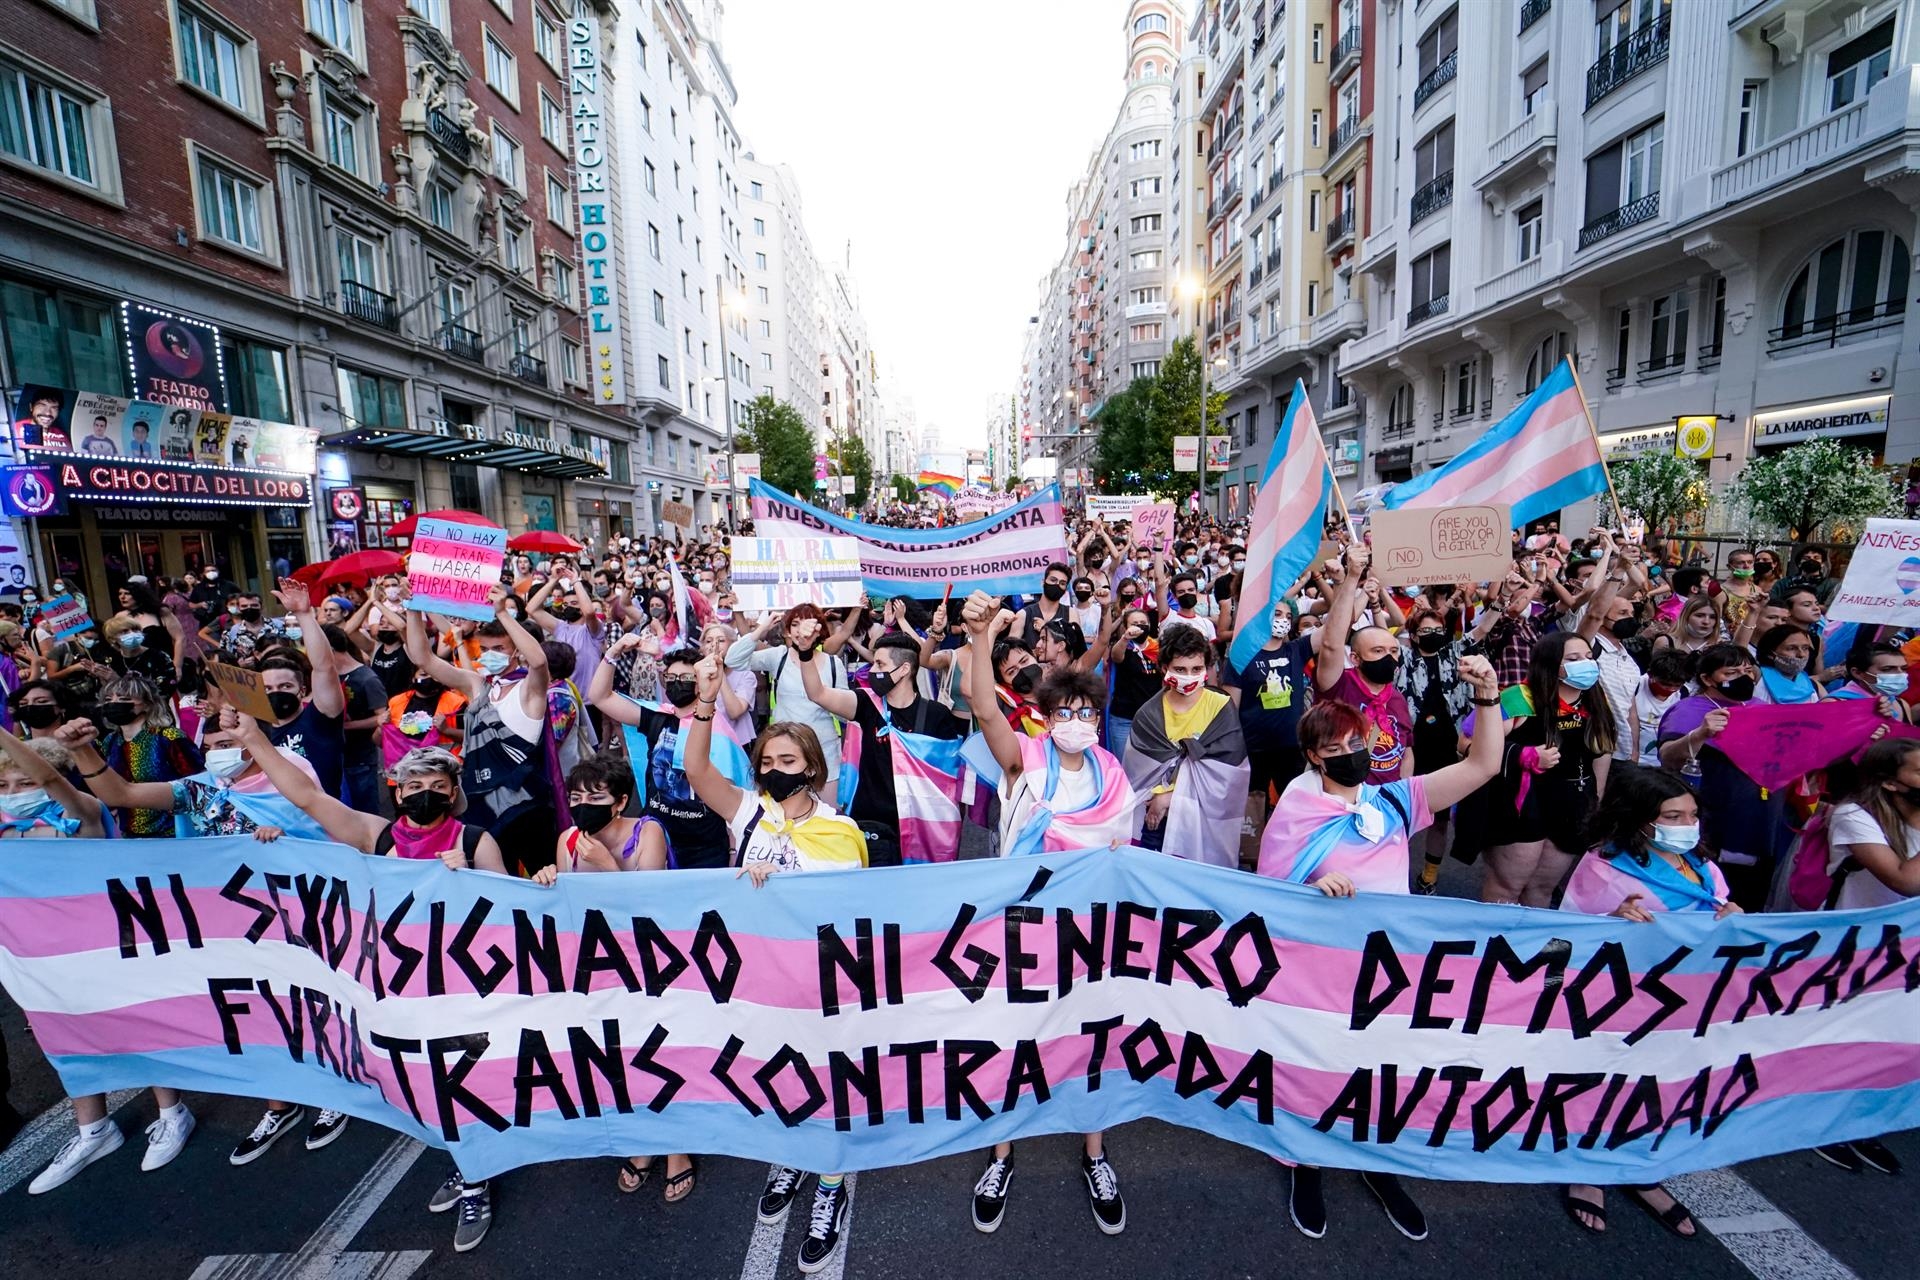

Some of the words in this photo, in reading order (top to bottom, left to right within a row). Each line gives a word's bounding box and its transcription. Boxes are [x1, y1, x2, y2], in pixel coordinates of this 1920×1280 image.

[571, 21, 604, 192] SENATOR
[582, 205, 612, 333] HOTEL
[150, 377, 209, 400] TEATRO
[147, 392, 217, 413] COMEDIA
[1765, 423, 1781, 435] LA
[1784, 411, 1872, 433] MARGHERITA
[504, 431, 560, 454] SENATOR
[1620, 434, 1648, 444] FATTO
[1651, 432, 1660, 440] IN
[1633, 440, 1658, 450] TUTTI
[62, 463, 83, 488] A
[89, 466, 209, 494] CHOCITA
[213, 475, 250, 496] DEL
[254, 478, 304, 498] LORO
[95, 506, 151, 521] TEATRO
[174, 509, 227, 522] COMEDIA
[1138, 509, 1169, 525] GAY
[1438, 516, 1461, 528] ARE
[1465, 516, 1489, 528] YOU
[417, 524, 434, 537] SI
[446, 527, 463, 541] NO
[472, 532, 498, 546] HAY
[1438, 530, 1448, 541] A
[1451, 528, 1476, 541] BOY
[1477, 527, 1494, 539] OR
[1861, 530, 1920, 551] NIÑES
[415, 540, 440, 553] LEY
[453, 546, 493, 563] TRANS
[755, 539, 835, 561] HARA
[1138, 538, 1172, 553] GRT
[1438, 541, 1447, 553] A
[1449, 540, 1486, 551] GIRL?
[432, 559, 481, 580] HABRA
[778, 559, 816, 584] LEY
[860, 563, 947, 578] STECIMIENTO
[950, 565, 966, 577] DE
[971, 555, 1050, 575] HORMONAS
[1406, 575, 1421, 584] LEY
[1424, 574, 1453, 583] TRANS
[1456, 573, 1471, 582] YA!
[762, 580, 835, 608] TRNS
[1839, 593, 1897, 608] FAMILIAS
[670, 808, 704, 820] LIGHTNING
[107, 873, 204, 959] NI
[219, 863, 352, 972] SEXO
[354, 887, 743, 1004] ASIGNADO
[817, 917, 904, 1017] NI
[931, 866, 1281, 1008] GÉNERO
[370, 1019, 687, 1142] TRANS
[710, 1033, 1052, 1132] CONTRA
[1081, 1014, 1274, 1125] TODA
